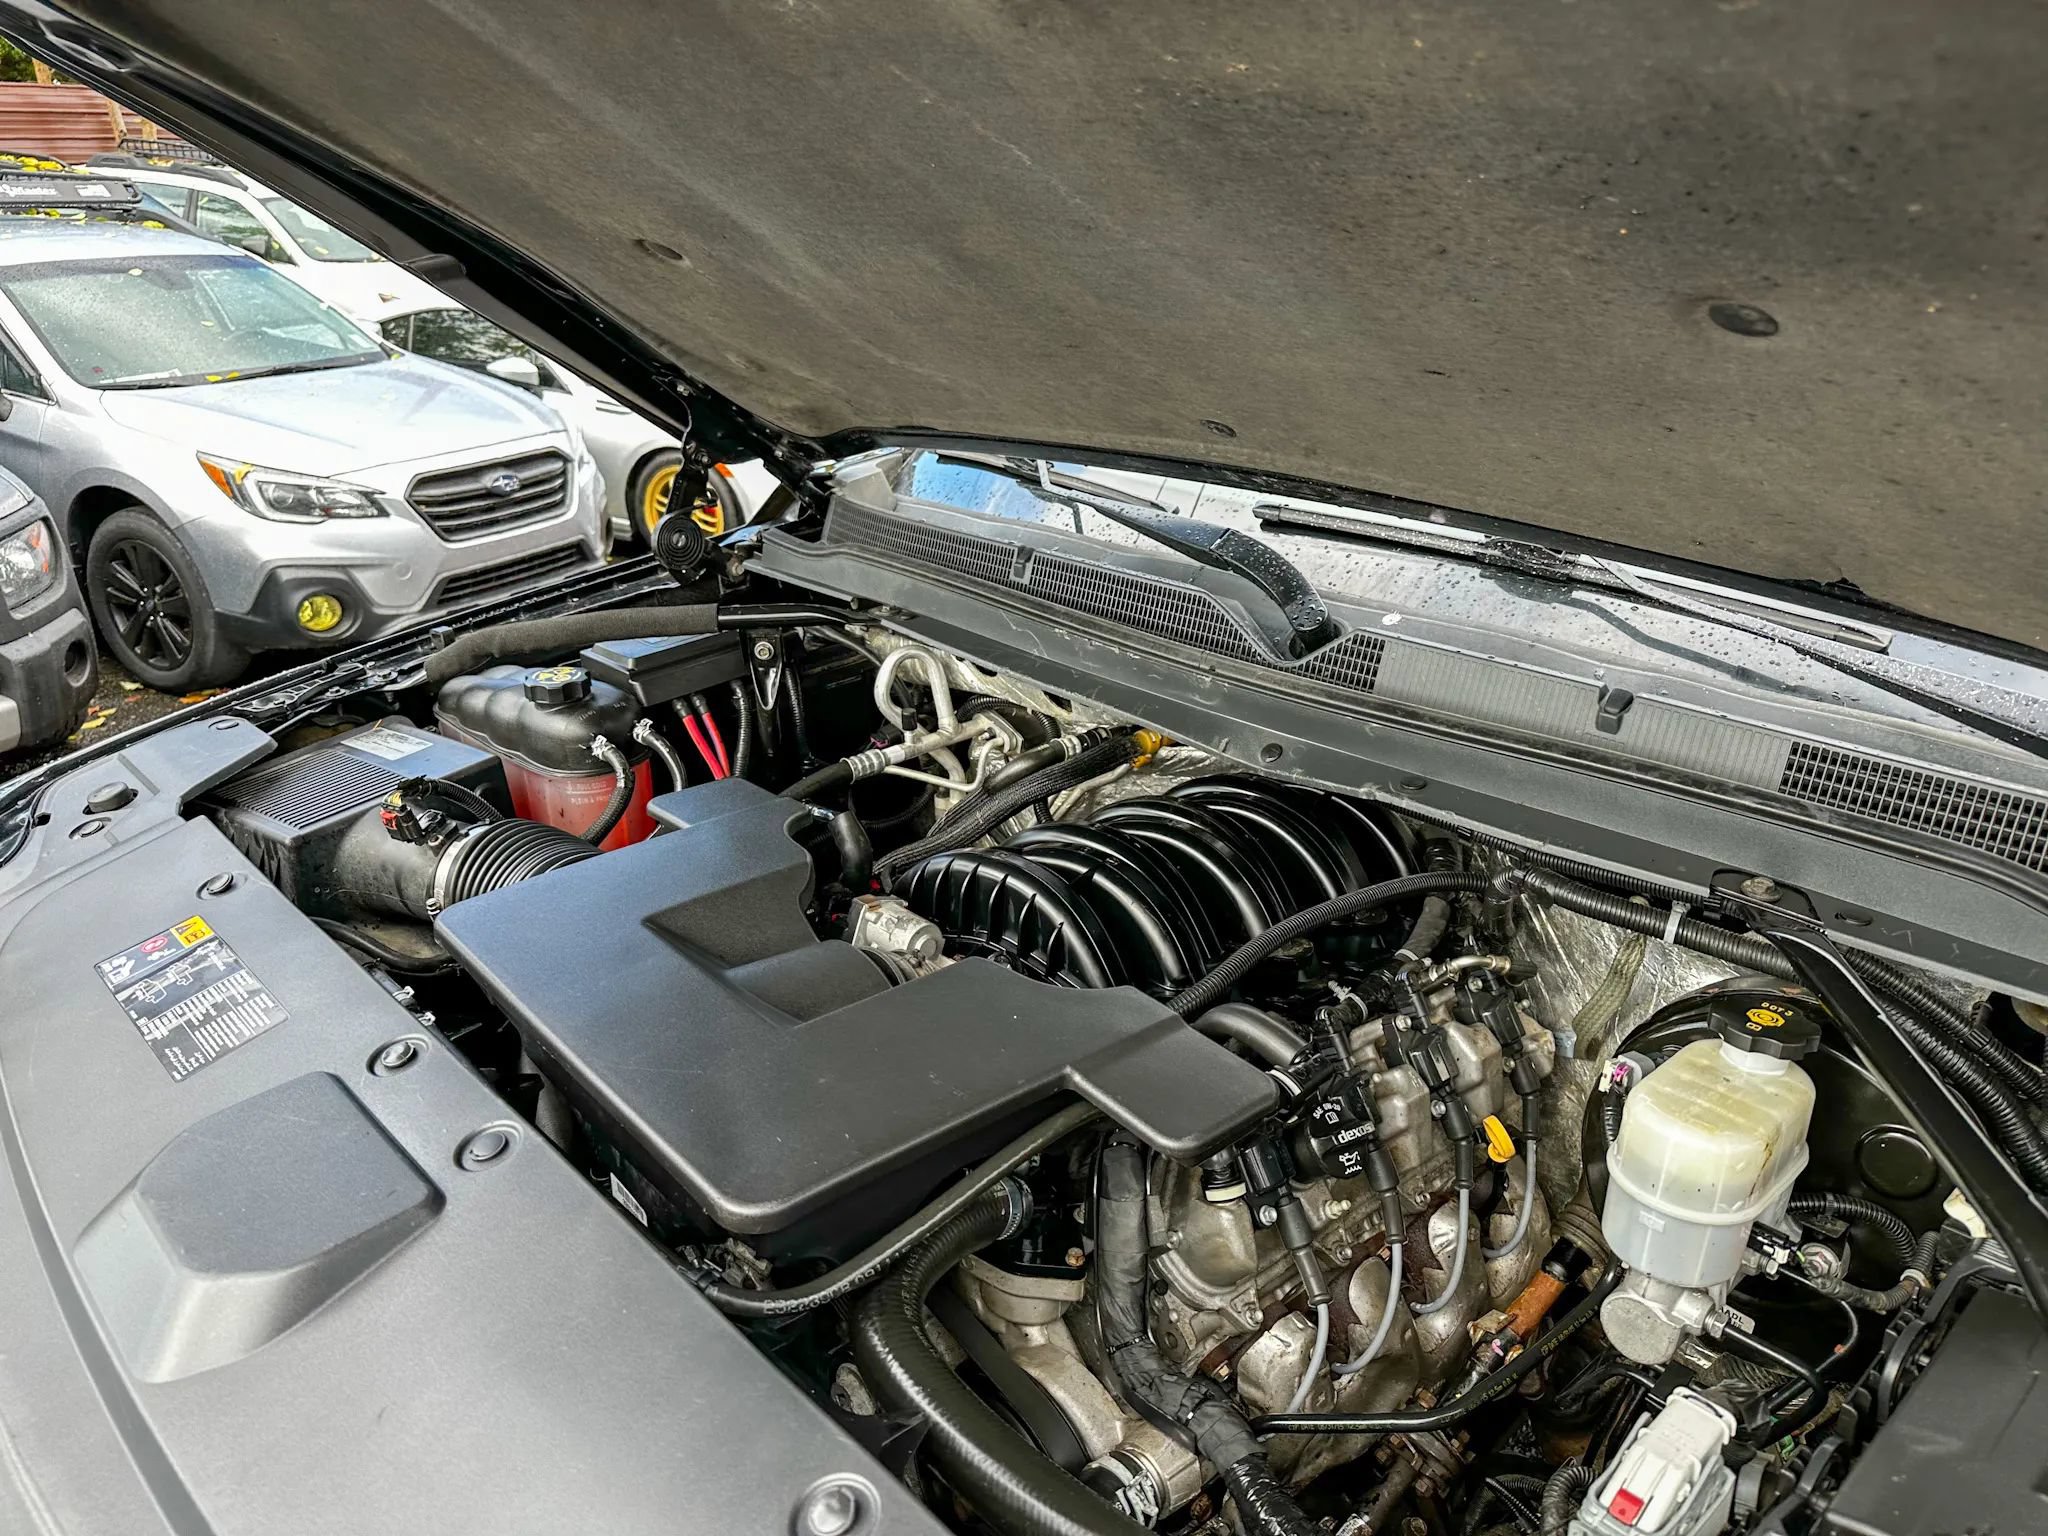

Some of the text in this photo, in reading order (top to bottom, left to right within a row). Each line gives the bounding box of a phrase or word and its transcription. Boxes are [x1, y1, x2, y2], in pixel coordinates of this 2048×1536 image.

[1760, 1001, 1794, 1017] DOT 3
[1312, 1102, 1341, 1119] SAE 0W-20
